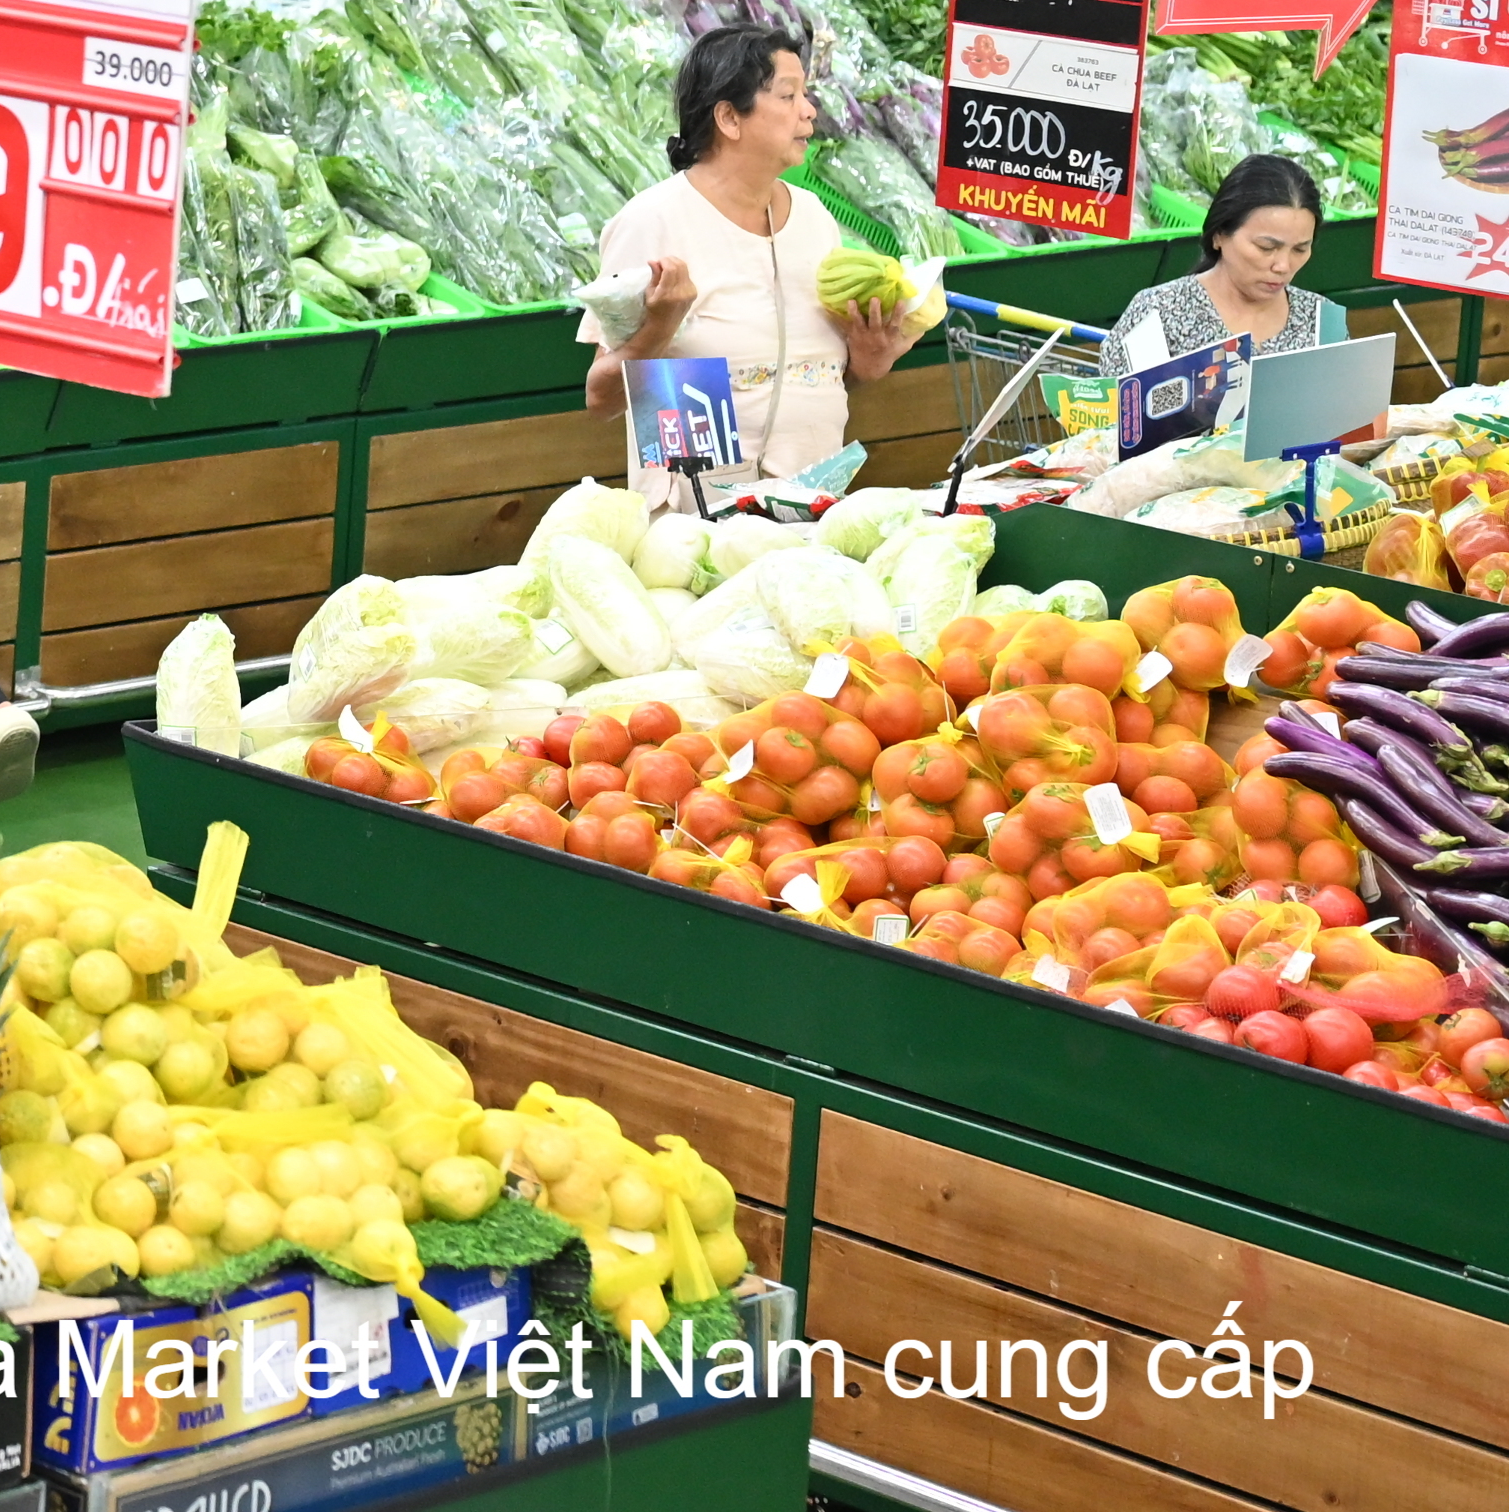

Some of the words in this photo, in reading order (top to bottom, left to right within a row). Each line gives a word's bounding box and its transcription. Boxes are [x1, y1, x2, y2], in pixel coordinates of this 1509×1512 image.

[95, 51, 172, 87] 39.000
[1067, 66, 1091, 77] CHUA
[1094, 70, 1117, 81] BEEF
[1067, 79, 1079, 89] ĐÀ
[1082, 82, 1100, 92] LẠT
[966, 156, 997, 171] +VAT
[1000, 161, 1030, 176] (BAO
[1034, 163, 1062, 182] GỒM
[959, 185, 1054, 219] KHUYẾN
[1061, 199, 1106, 228] MÃI
[331, 1442, 373, 1473] SJDC
[375, 1422, 448, 1463] PRODUCE
